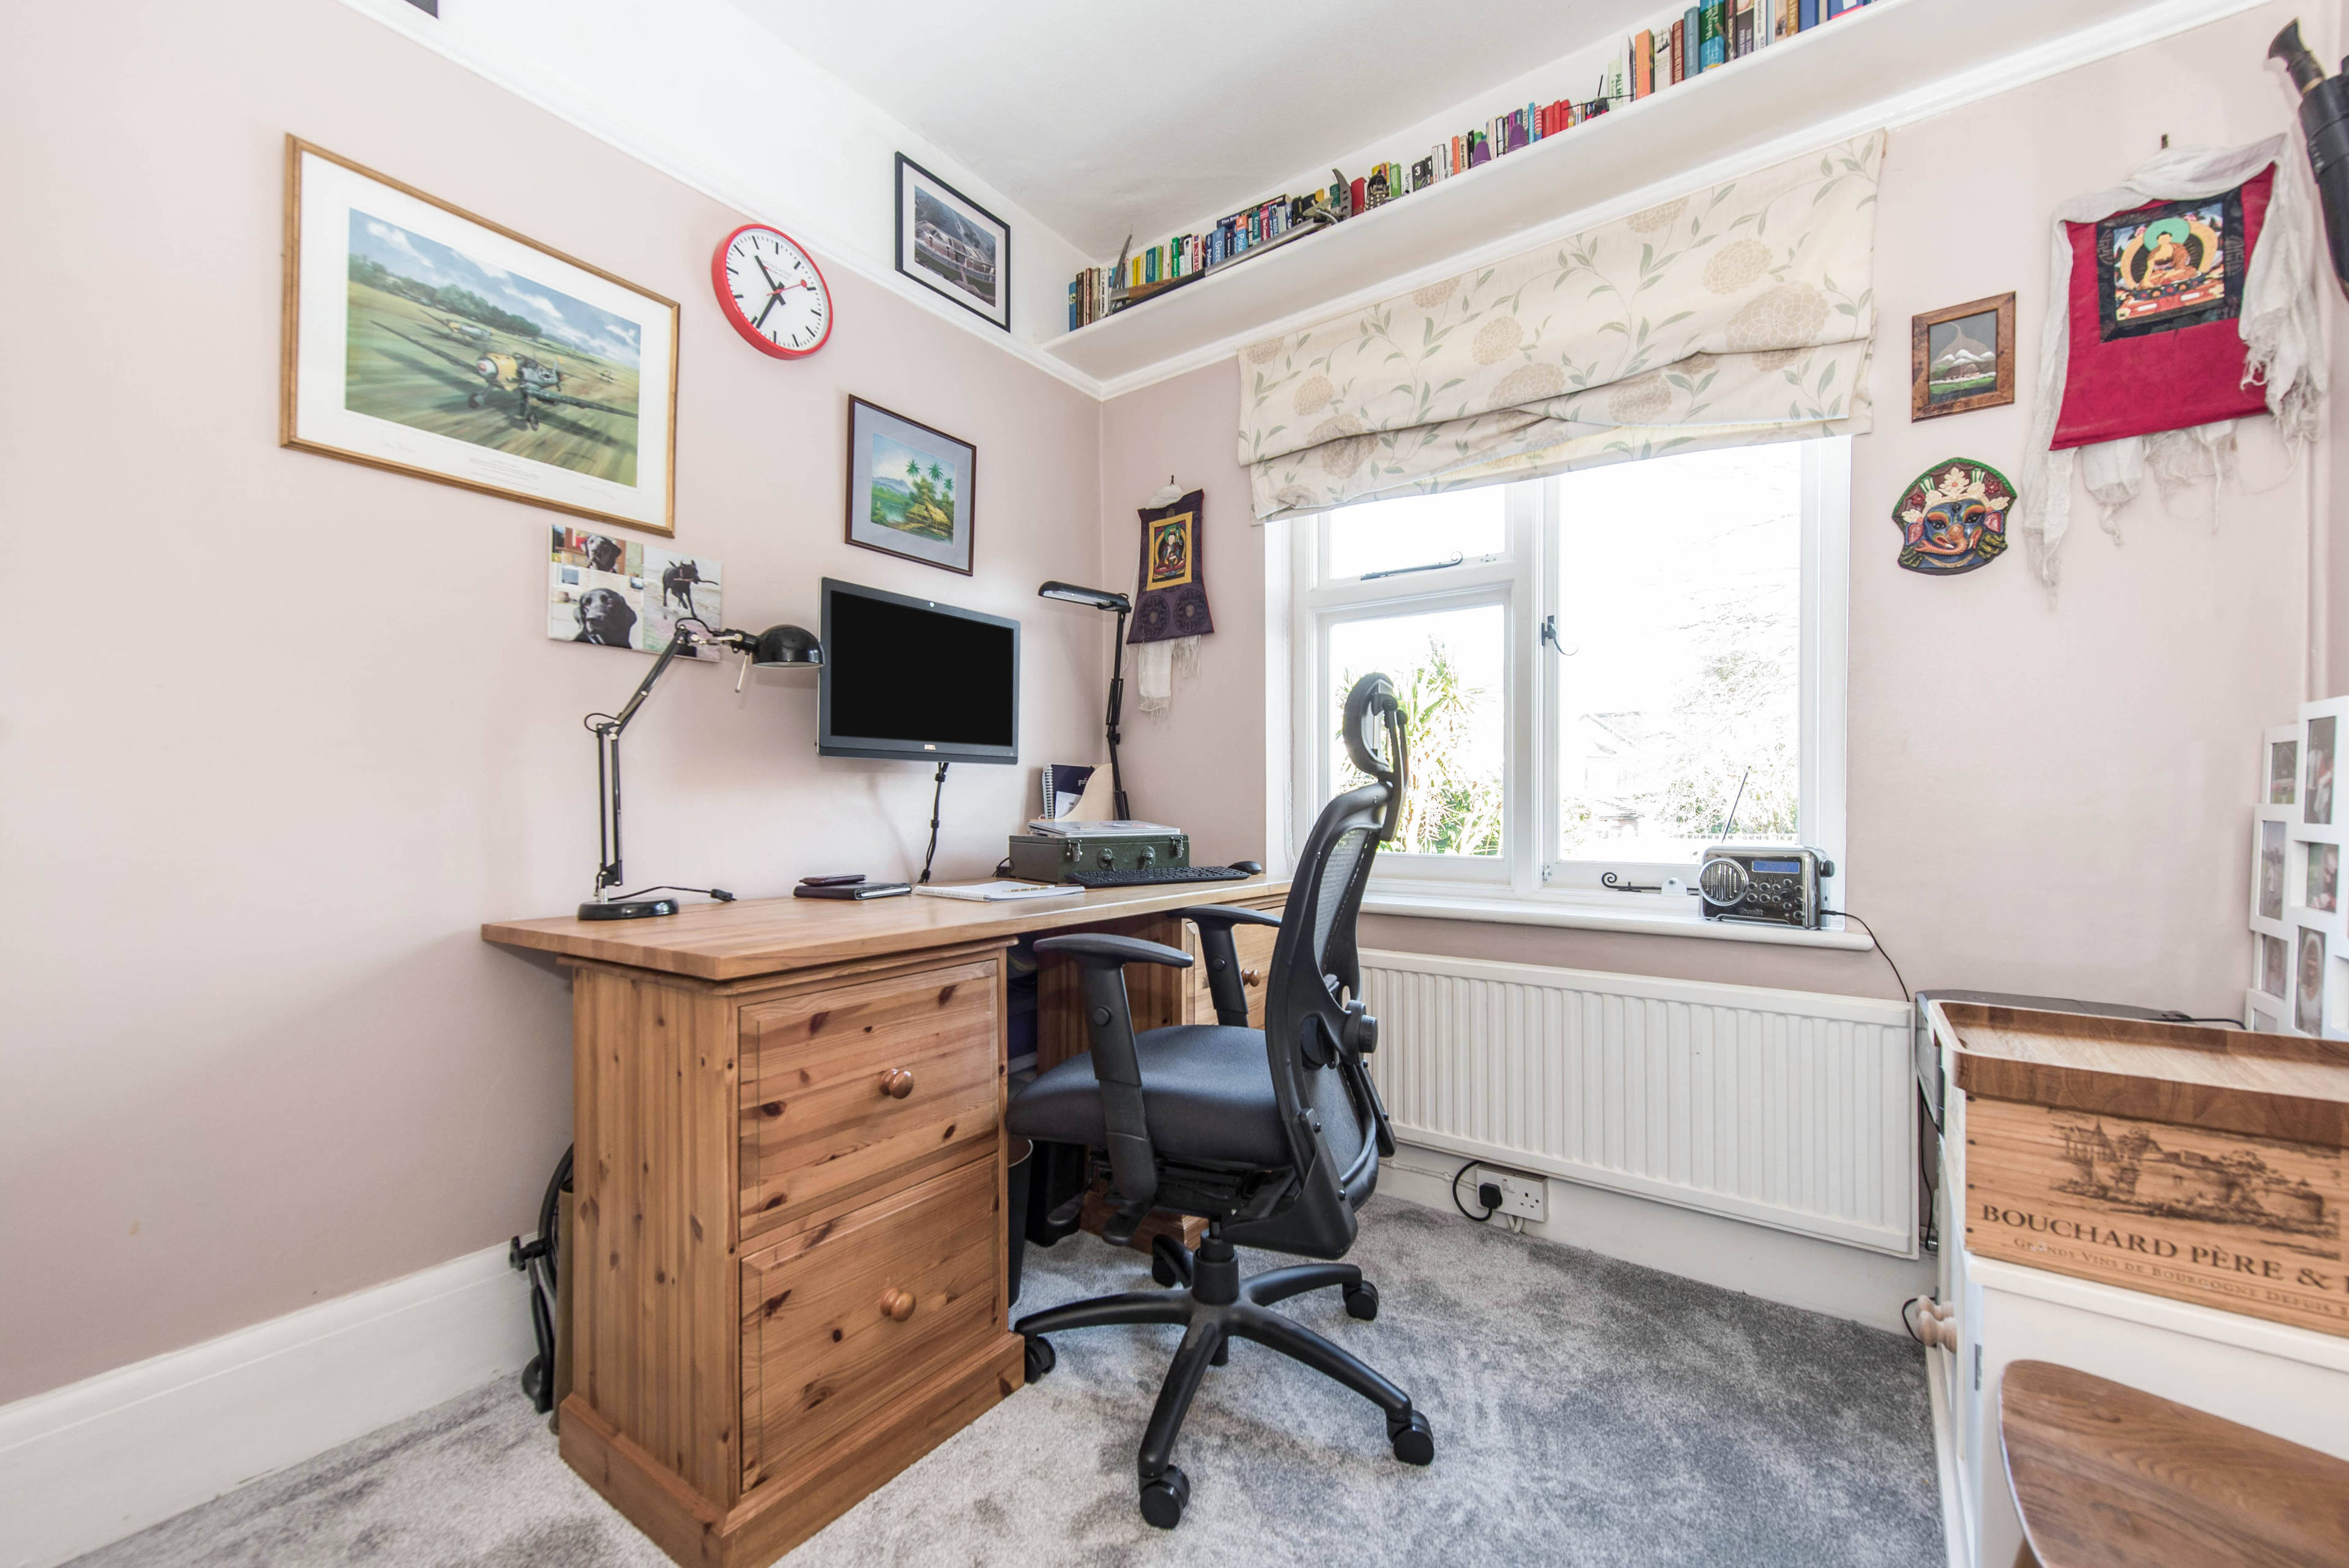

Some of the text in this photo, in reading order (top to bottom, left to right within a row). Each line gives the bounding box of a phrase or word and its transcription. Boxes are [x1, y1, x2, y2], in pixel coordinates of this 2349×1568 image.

[1415, 165, 1421, 176] 3
[1427, 160, 1432, 170] 1
[1983, 1205, 2332, 1290] BOUCHARD PÈRE &
